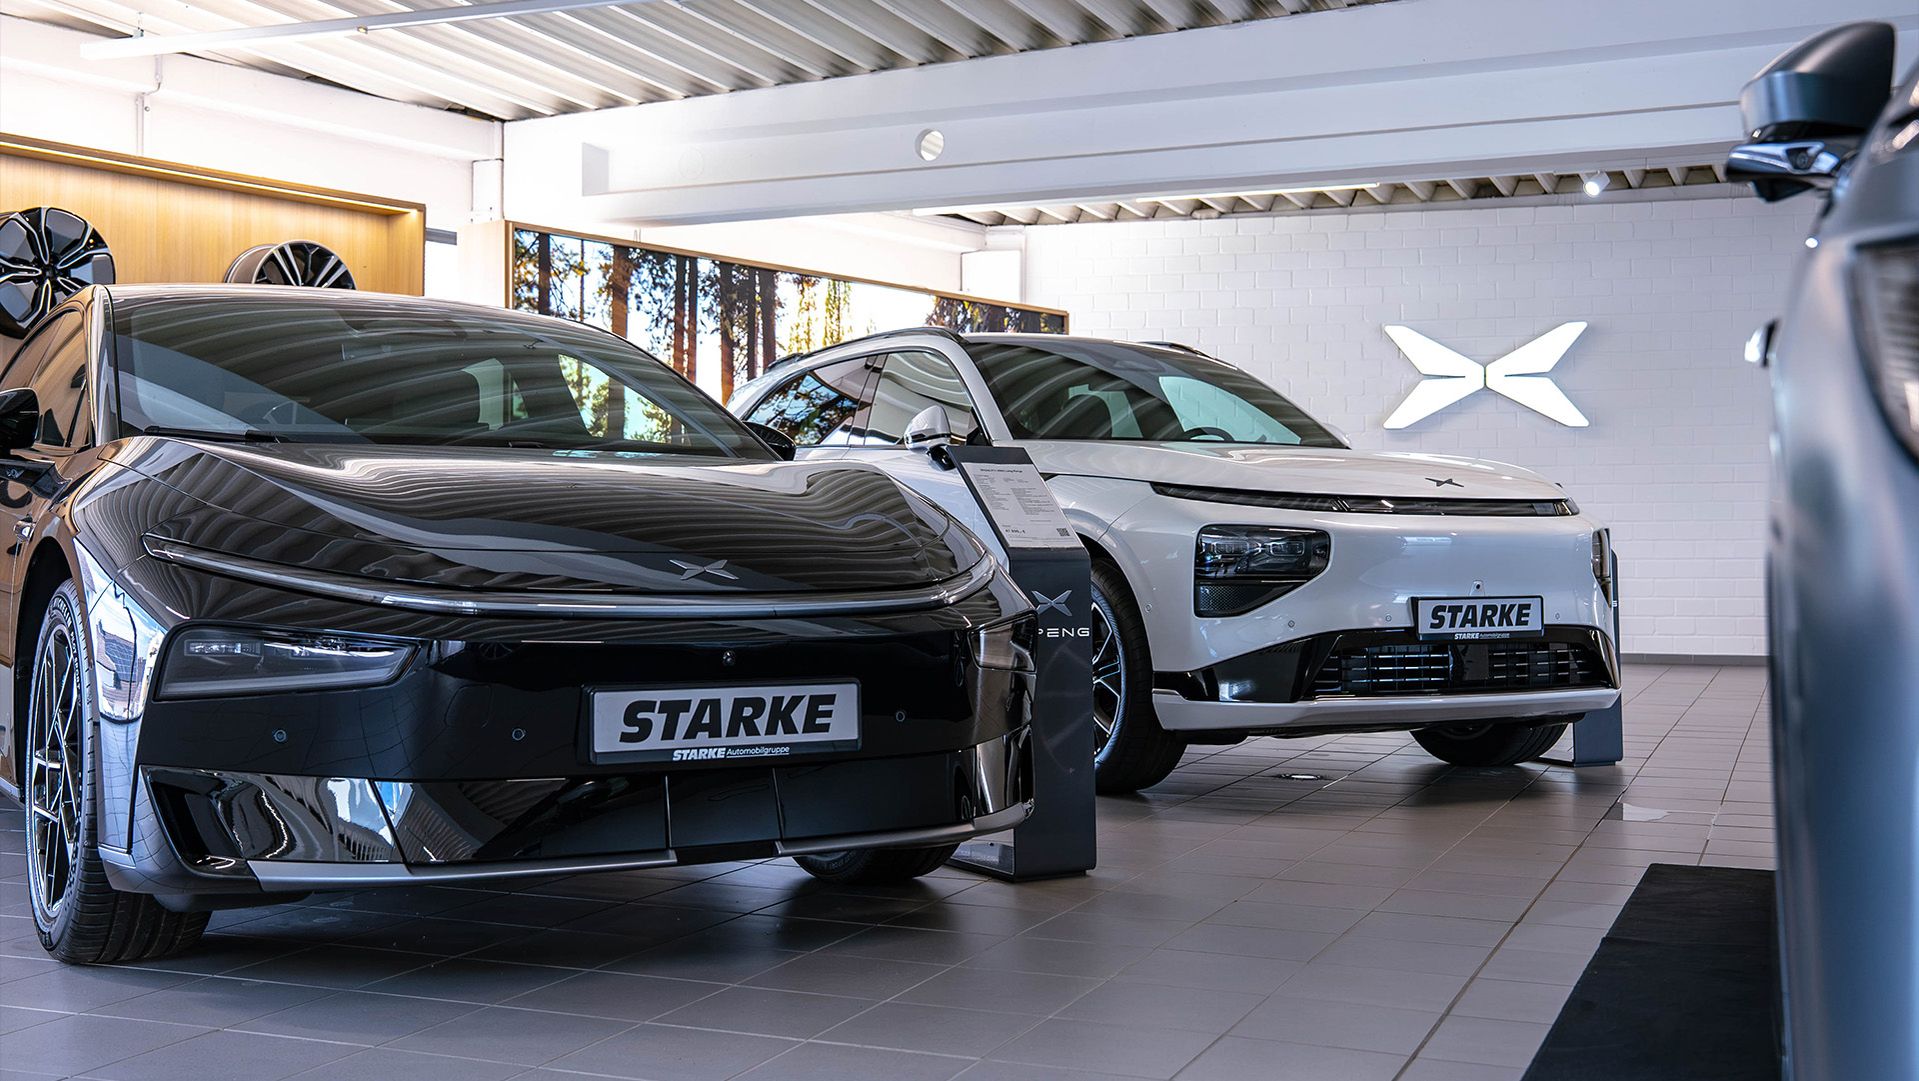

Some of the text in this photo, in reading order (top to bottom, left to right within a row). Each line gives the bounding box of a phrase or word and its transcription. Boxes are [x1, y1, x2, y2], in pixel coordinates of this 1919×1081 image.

[1430, 604, 1531, 629] STARKE
[619, 694, 837, 743] STARKE
[672, 746, 790, 762] STARKE Automobilgruppe
